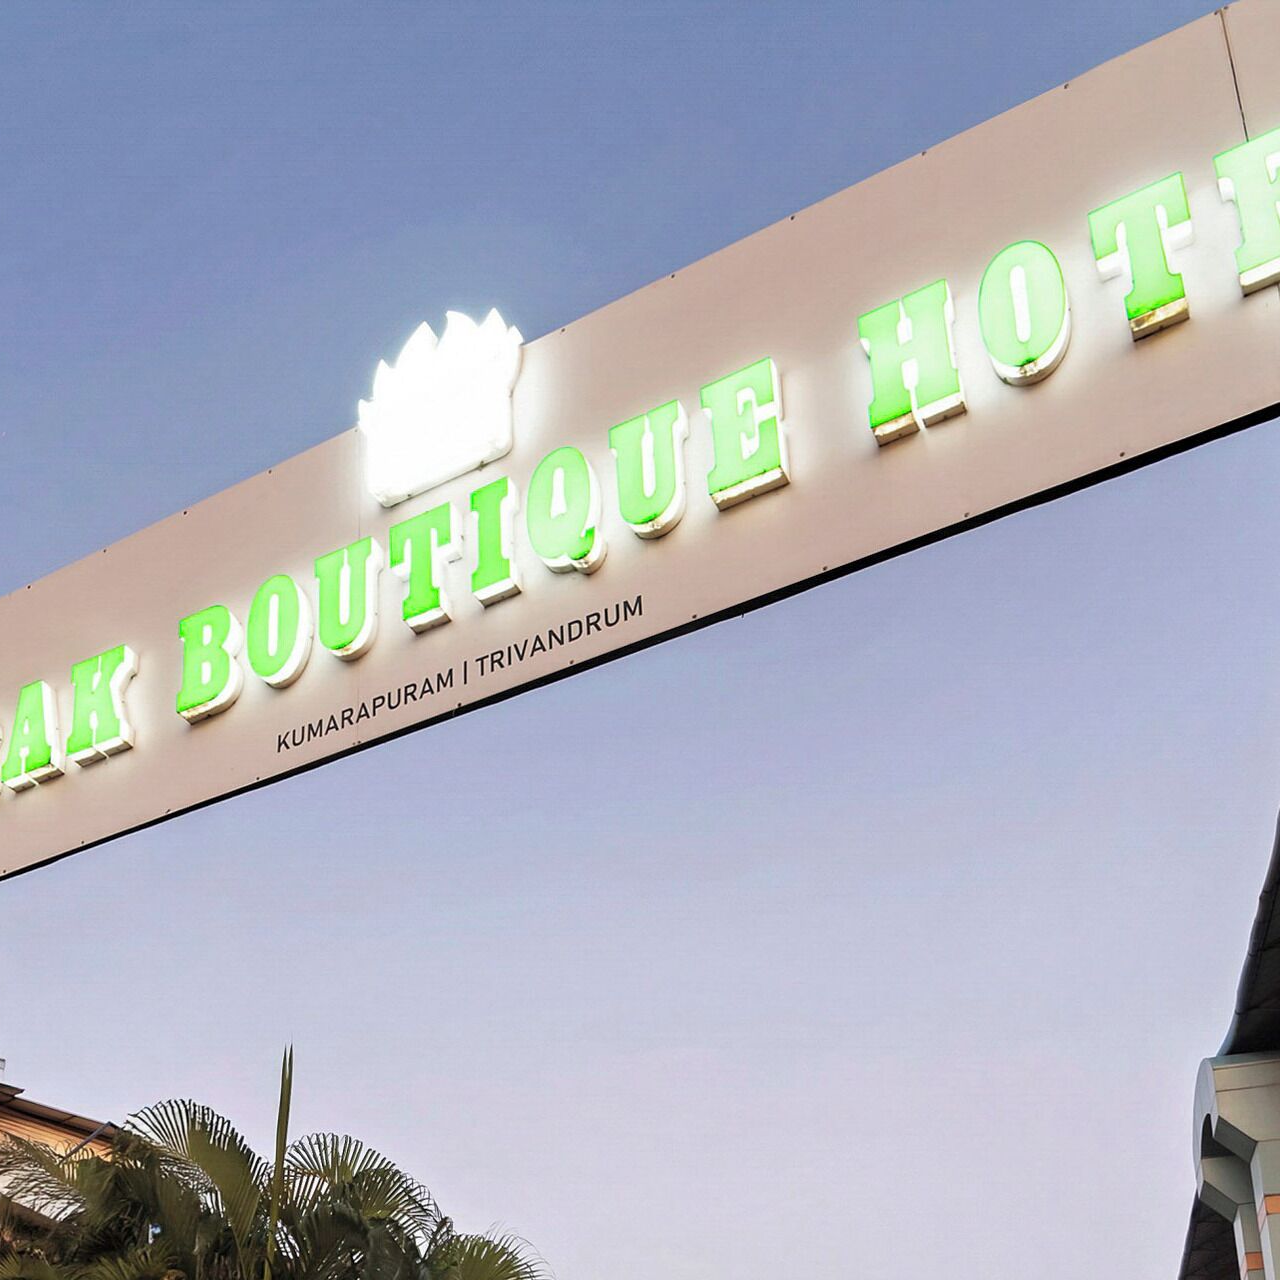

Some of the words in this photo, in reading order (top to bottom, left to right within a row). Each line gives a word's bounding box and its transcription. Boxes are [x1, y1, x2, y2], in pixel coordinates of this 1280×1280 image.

[175, 356, 791, 725] BOUTIQUE
[276, 668, 455, 753] KUMARAPURAM
[474, 595, 644, 677] TRIVANDRUM
